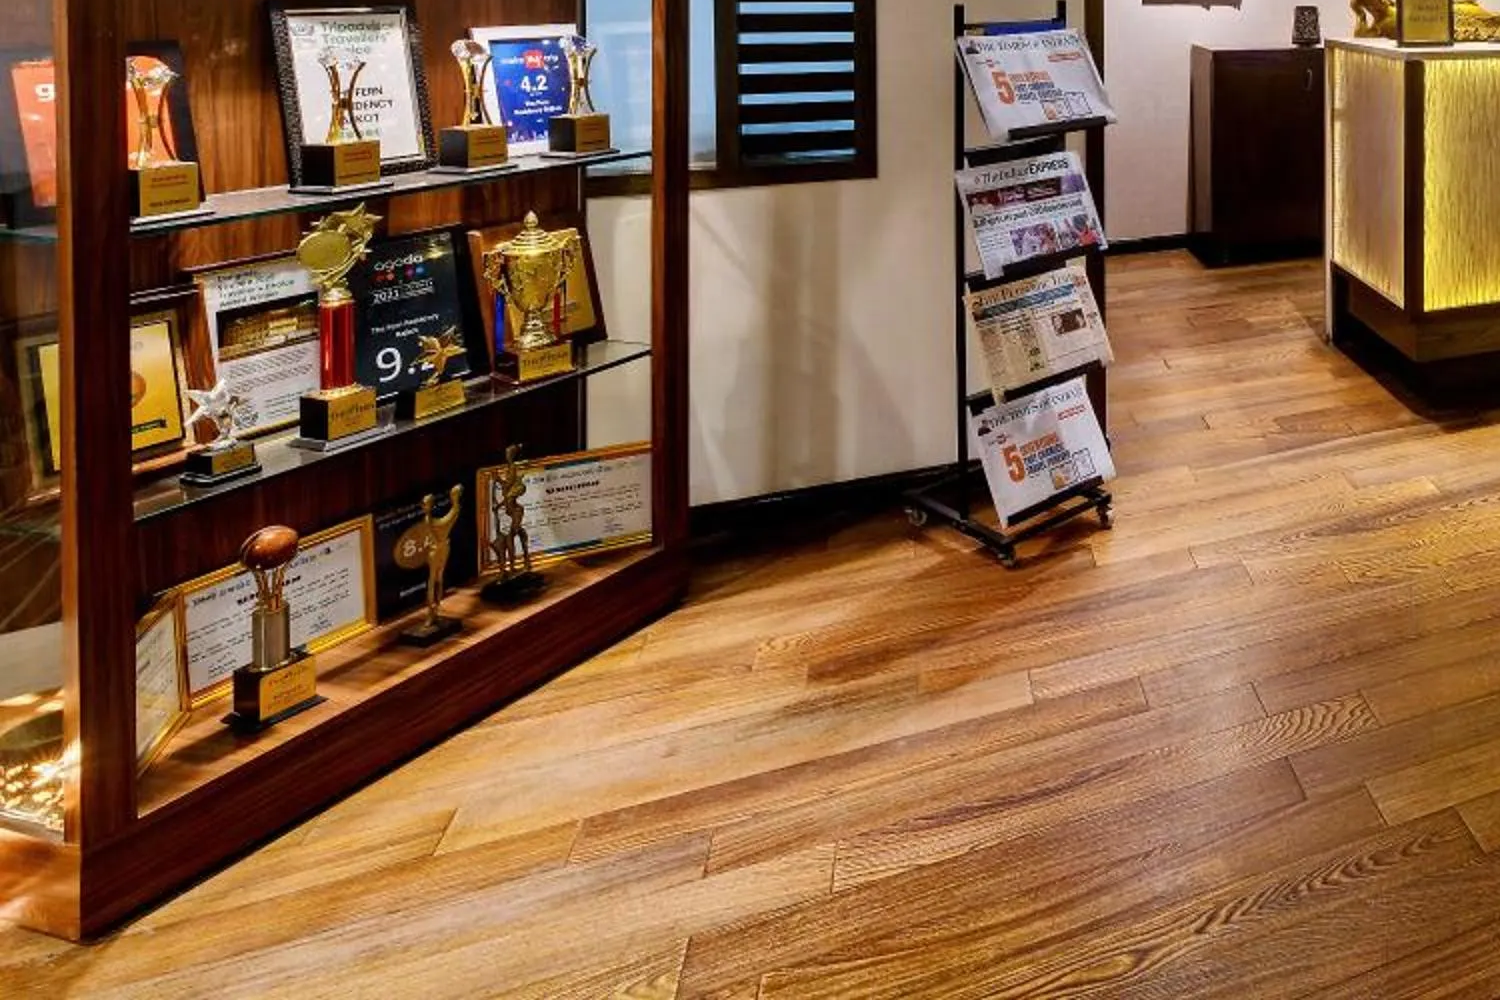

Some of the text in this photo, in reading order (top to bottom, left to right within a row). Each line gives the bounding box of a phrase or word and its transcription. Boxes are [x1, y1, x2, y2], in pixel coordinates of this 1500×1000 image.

[520, 74, 549, 92] 4.2
[991, 71, 1016, 105] 5
[1003, 443, 1025, 482] 5
